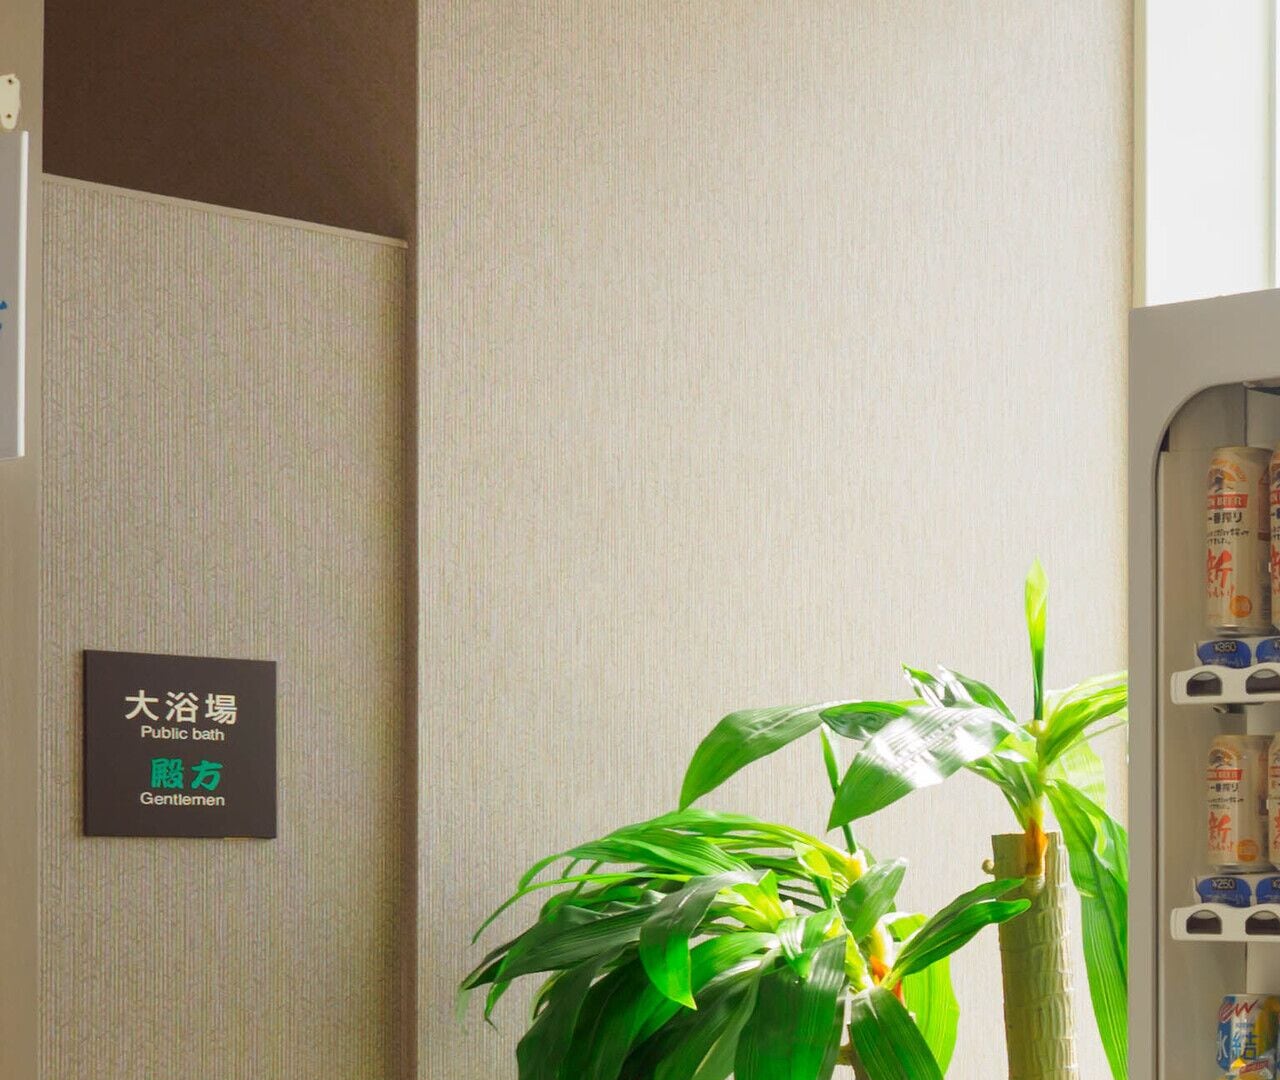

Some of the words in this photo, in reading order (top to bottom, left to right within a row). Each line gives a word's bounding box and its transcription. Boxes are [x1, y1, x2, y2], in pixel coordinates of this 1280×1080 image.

[125, 690, 238, 725] 大浴場
[141, 725, 189, 740] Public
[192, 728, 226, 741] bath
[151, 757, 224, 791] 殿方
[140, 791, 226, 807] Gentlemen
